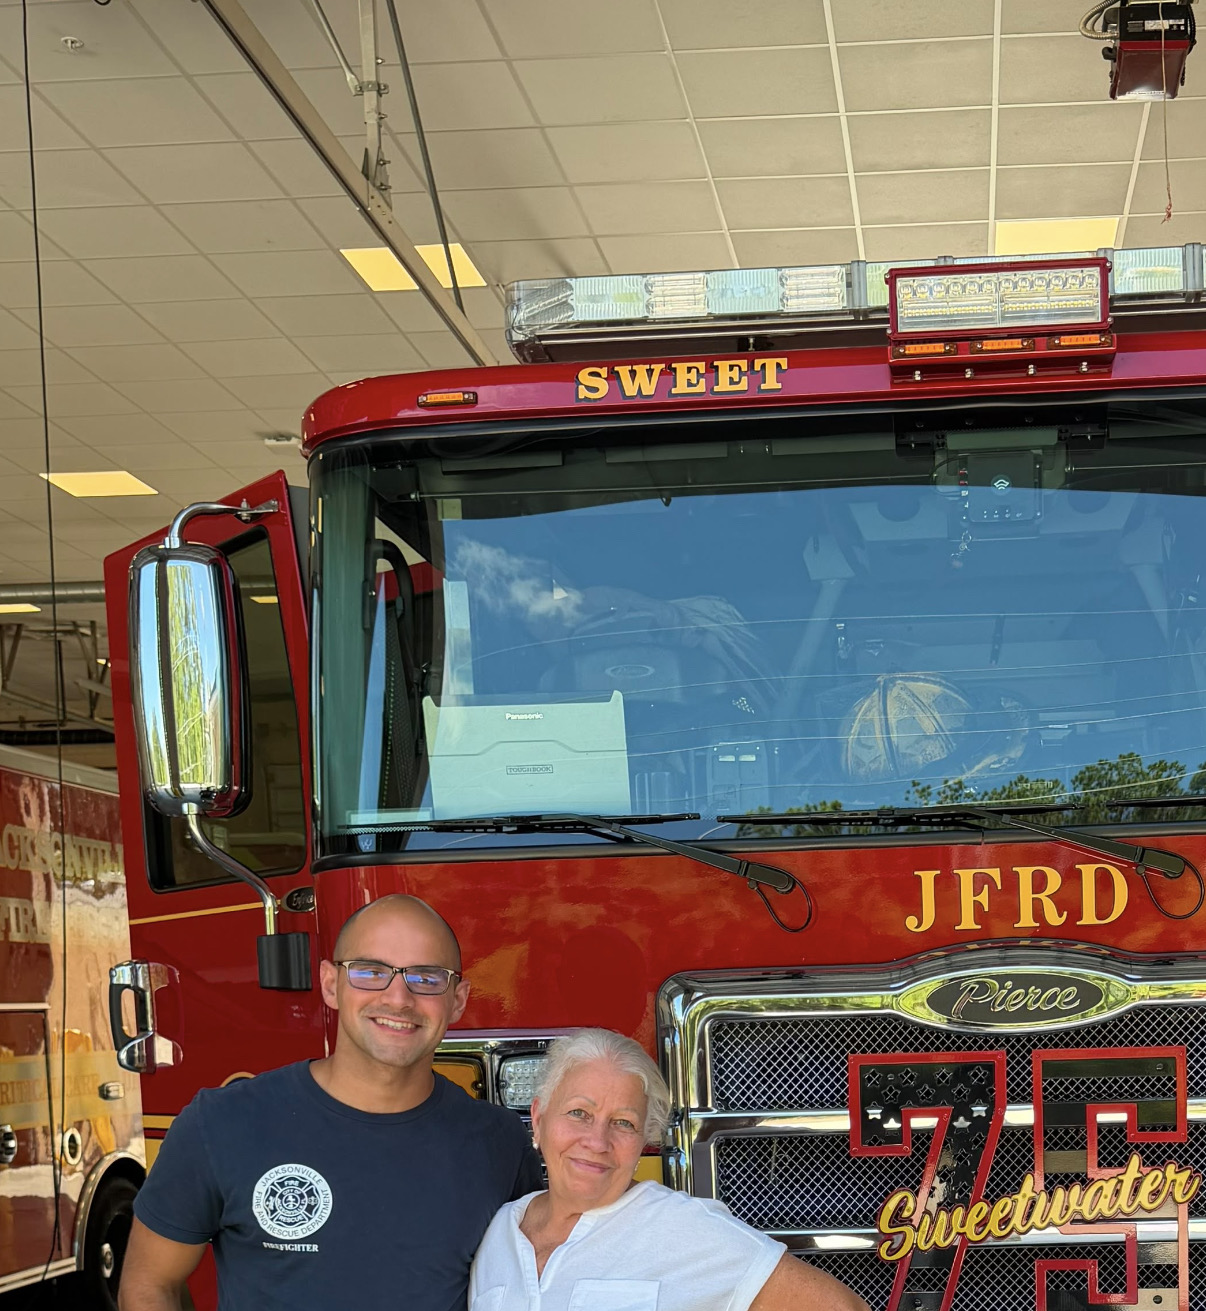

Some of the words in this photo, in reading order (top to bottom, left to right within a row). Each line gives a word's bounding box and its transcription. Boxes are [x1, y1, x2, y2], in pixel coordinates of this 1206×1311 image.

[576, 357, 788, 402] SWEET
[505, 712, 544, 720] Panasonic
[507, 766, 552, 774] TOUGHBOOK
[905, 864, 1129, 933] JFRD
[951, 978, 1081, 1019] Pierce
[261, 1166, 323, 1187] JACKSONVILLE
[255, 1190, 263, 1209] FIRE
[877, 1153, 1202, 1261] Sweetwater
[257, 1210, 268, 1226] AND
[300, 1189, 330, 1234] DEPARTMENT
[266, 1223, 300, 1238] RESCUE
[262, 1241, 319, 1252] FIREFIGHTER
